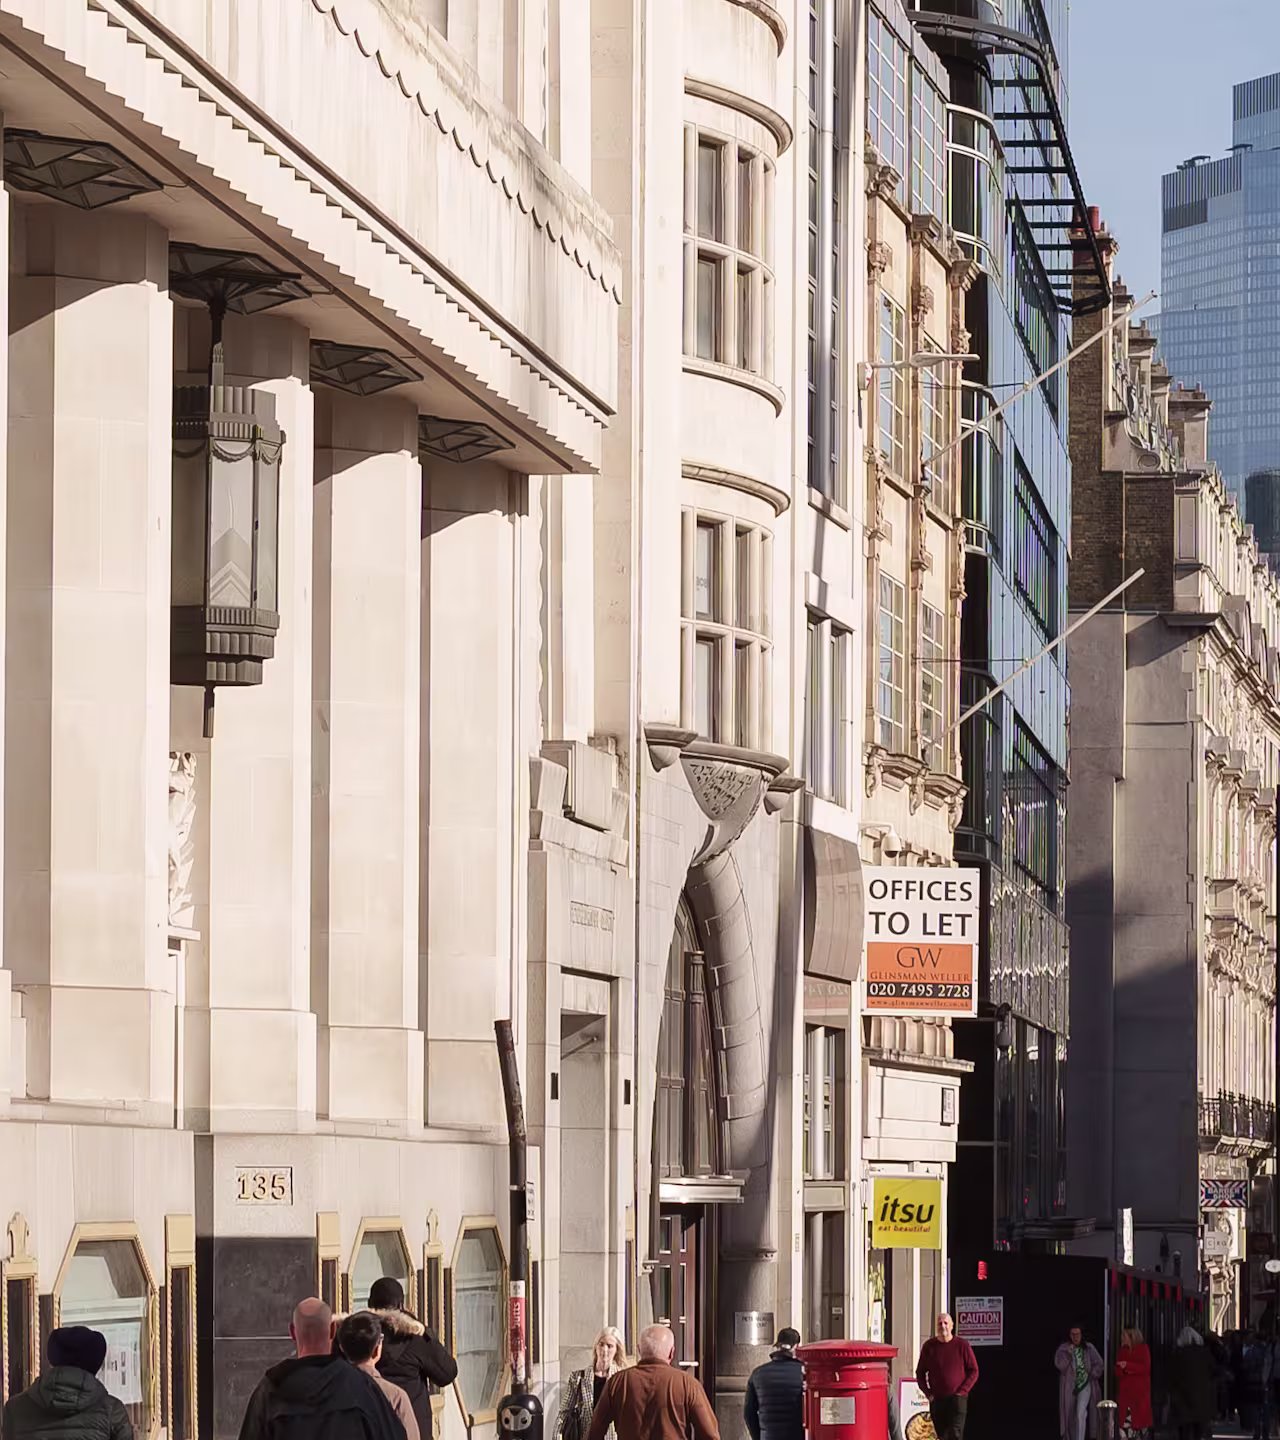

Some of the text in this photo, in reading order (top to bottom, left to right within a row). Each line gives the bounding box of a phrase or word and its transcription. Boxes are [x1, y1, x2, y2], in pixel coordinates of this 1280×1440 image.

[869, 879, 973, 902] OFFICES
[869, 911, 973, 937] TO LET
[896, 946, 943, 968] GW
[870, 971, 971, 982] GLINSMAN WELLER
[869, 983, 971, 998] 020 7495 2728
[237, 1173, 286, 1201] 135
[880, 1195, 934, 1224] itsu
[893, 1225, 931, 1233] beautiful
[959, 1312, 1000, 1324] CAUTION
